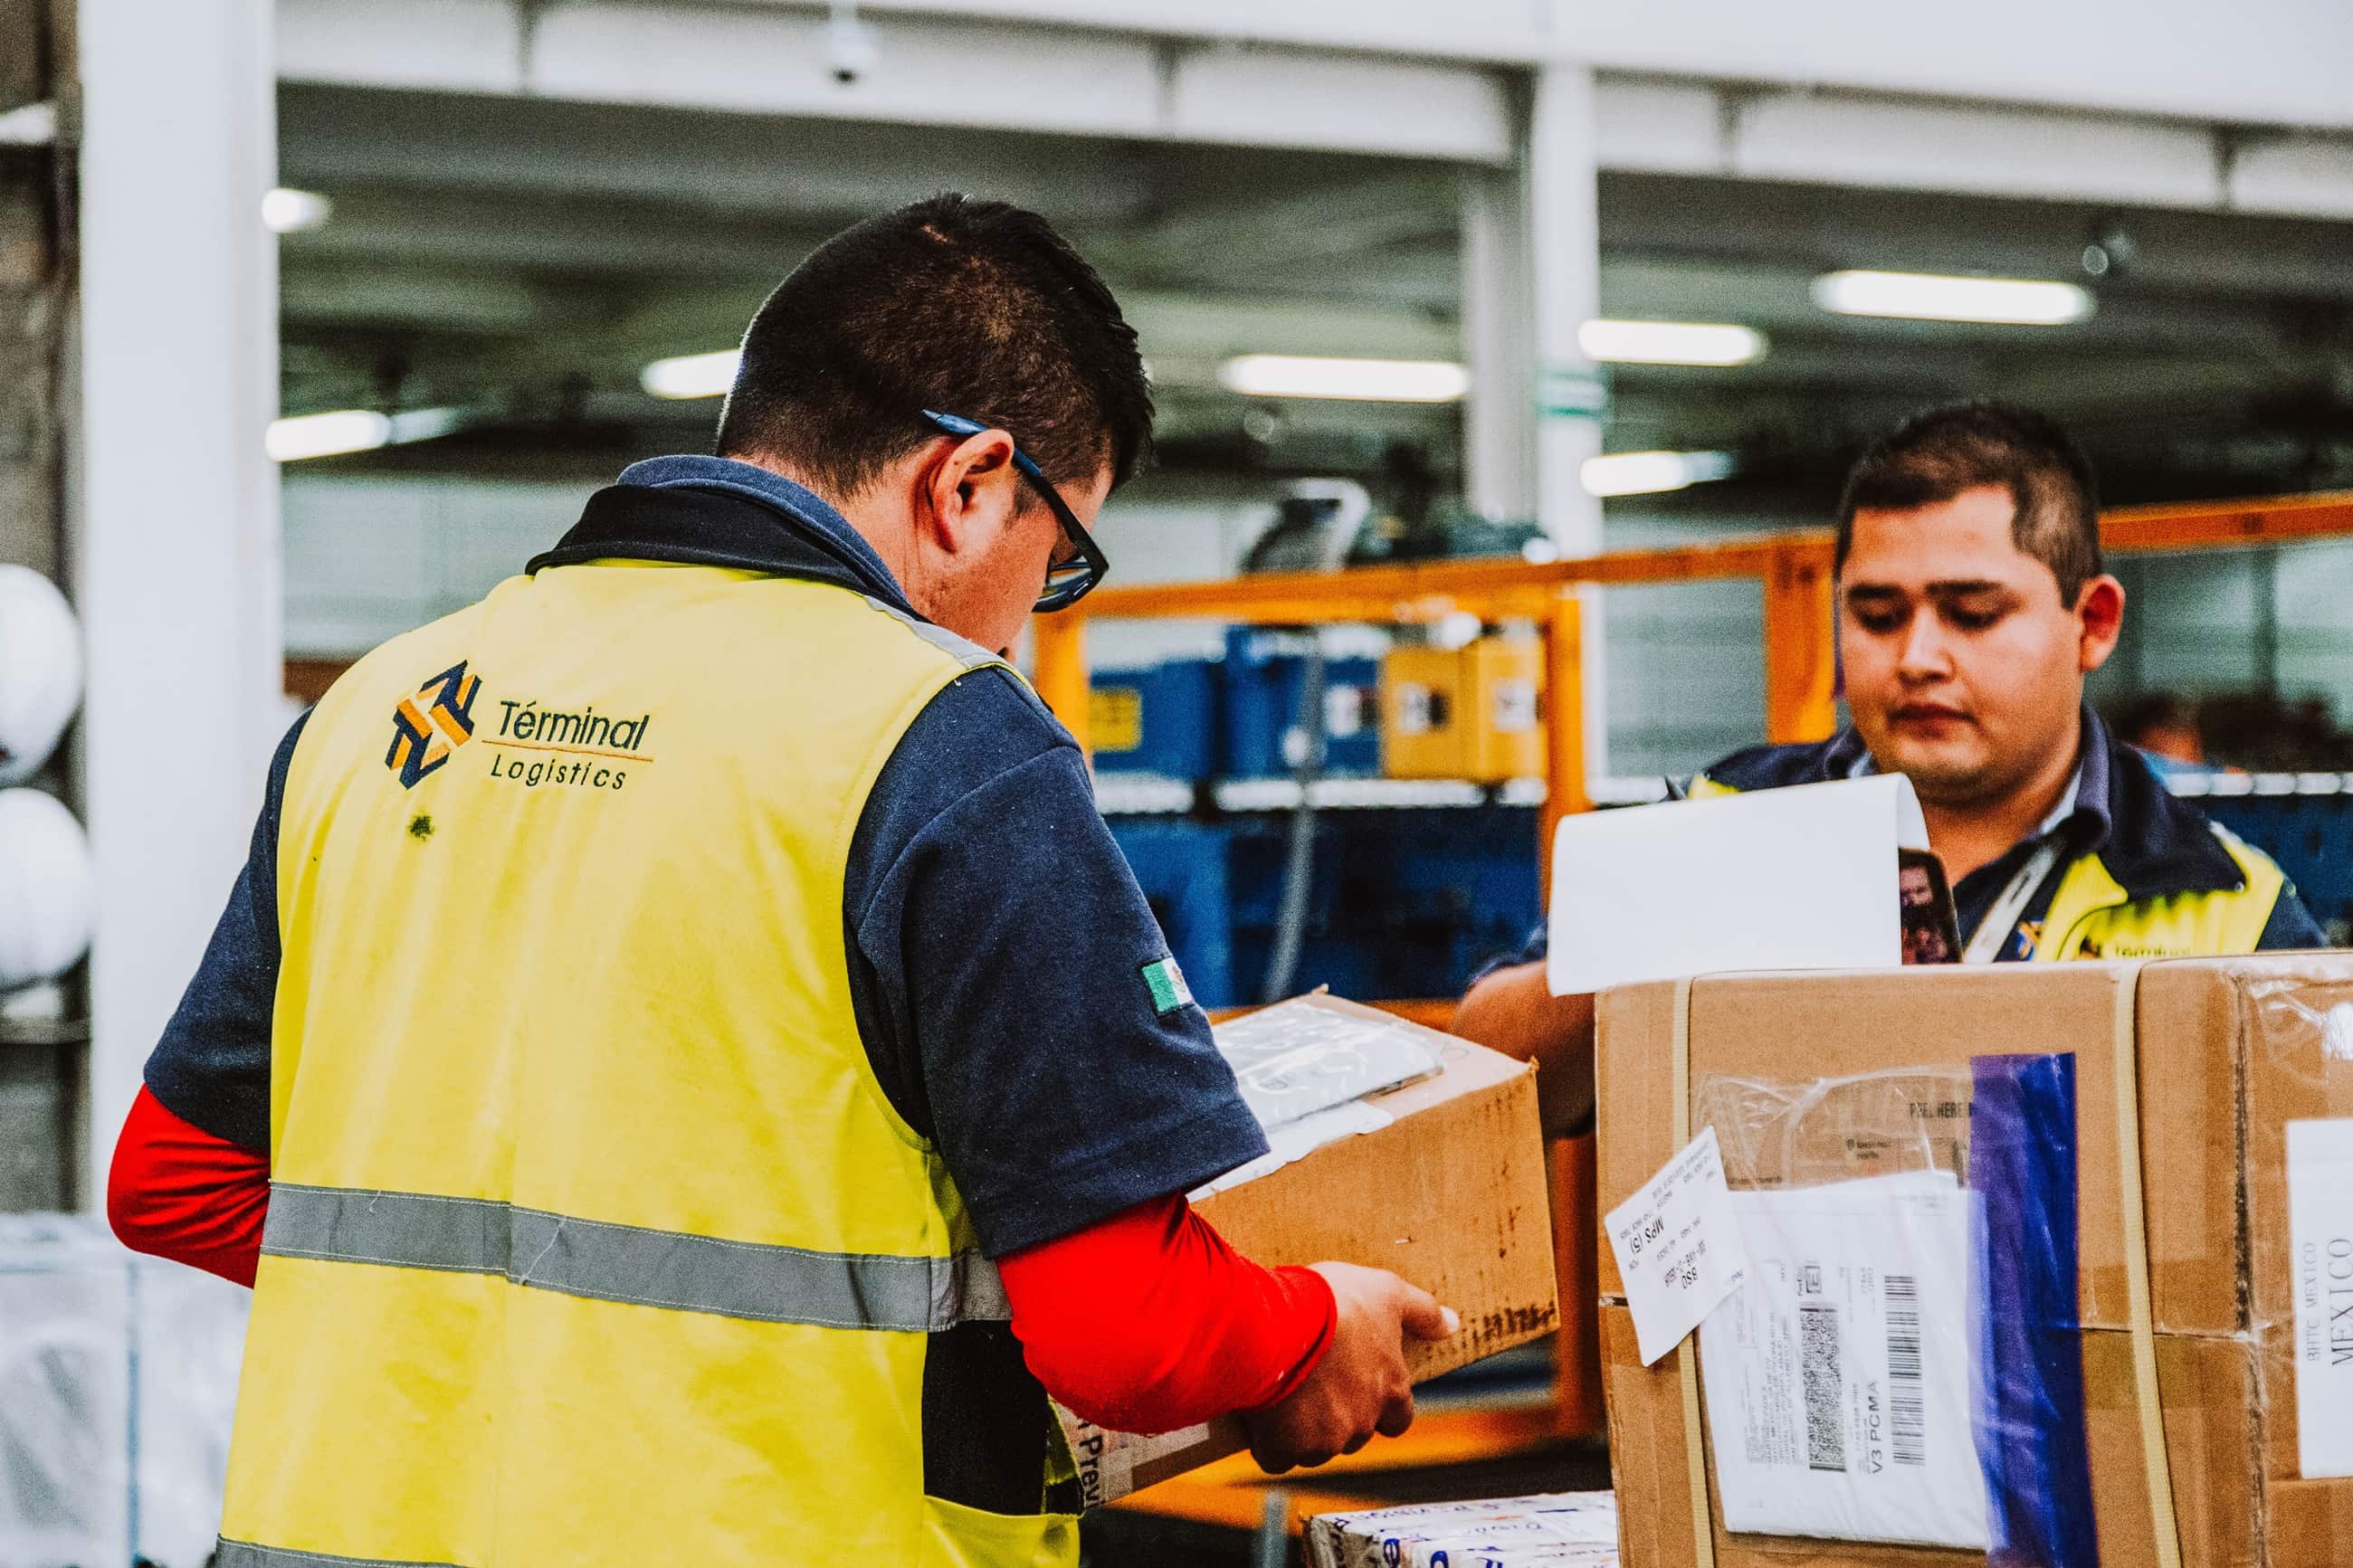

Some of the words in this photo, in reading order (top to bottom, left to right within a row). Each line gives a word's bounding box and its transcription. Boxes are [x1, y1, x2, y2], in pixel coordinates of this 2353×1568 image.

[500, 699, 651, 751] Términal
[491, 754, 626, 790] Logistics
[1629, 1233, 1643, 1255] (5)
[1645, 1216, 1665, 1244] MPS
[2303, 1242, 2319, 1309] MEXICO
[2327, 1238, 2353, 1367] MEXICO
[1867, 1381, 1881, 1442] PCMA
[1870, 1449, 1883, 1475] V3
